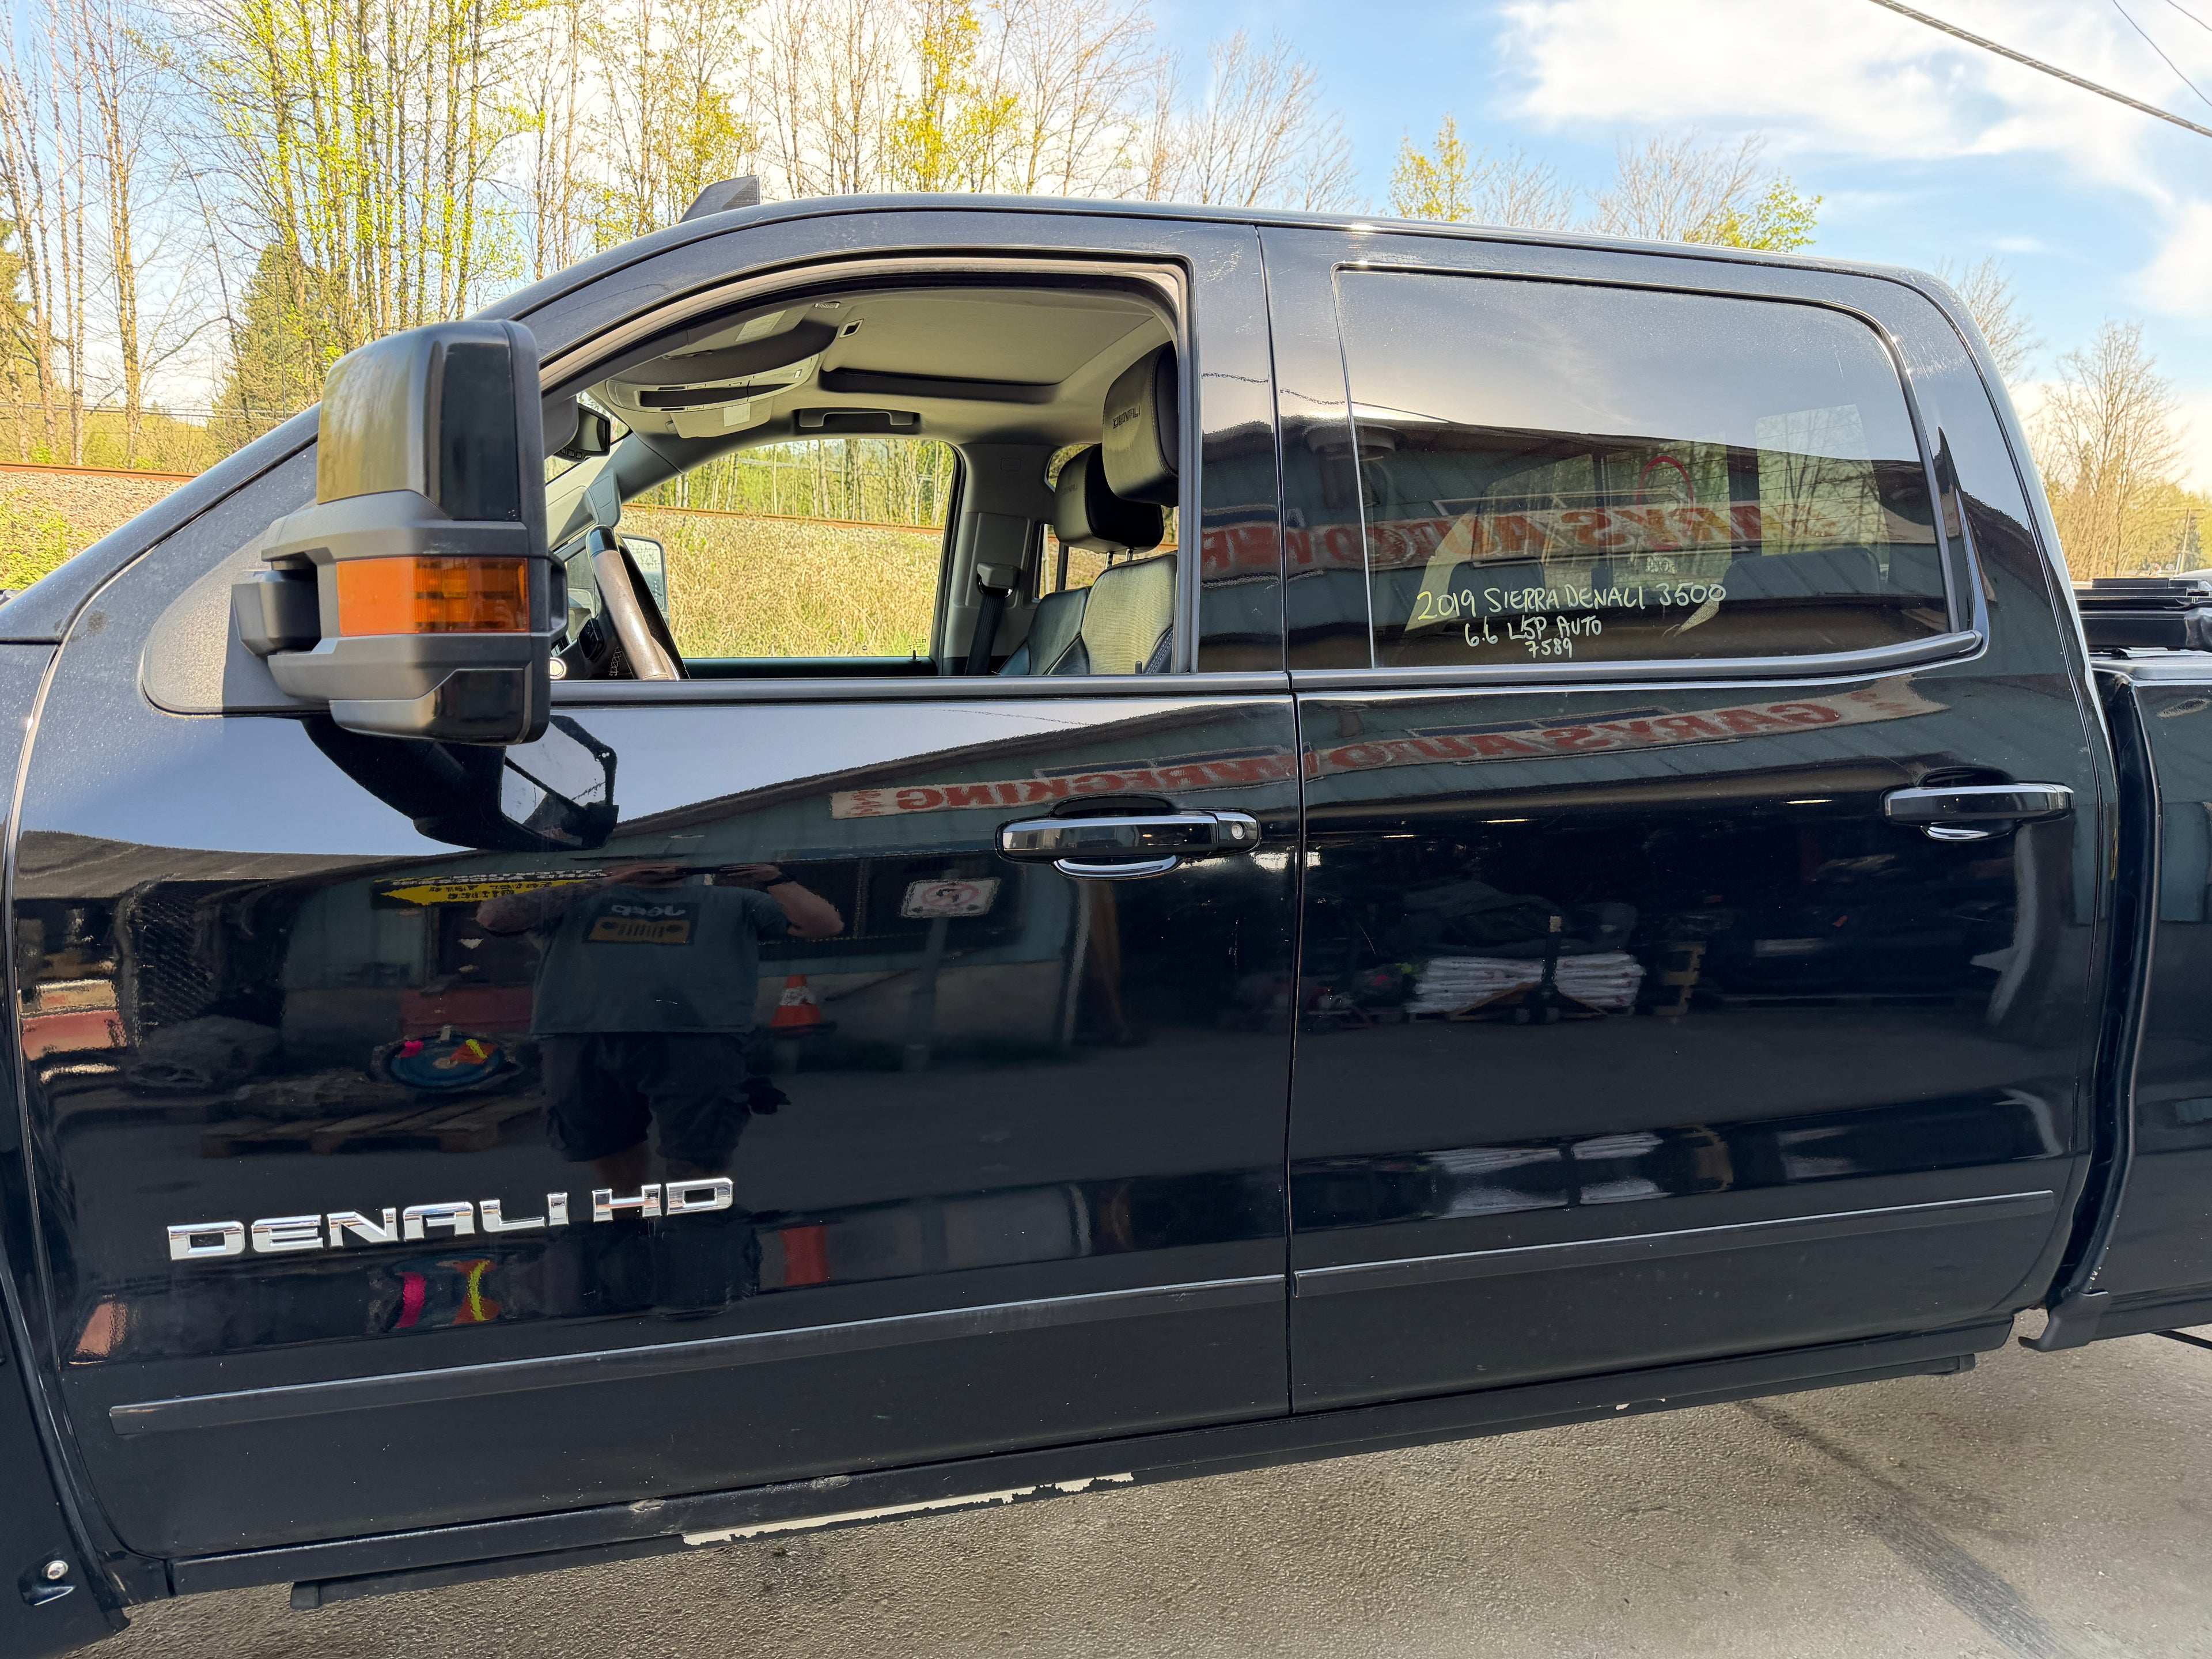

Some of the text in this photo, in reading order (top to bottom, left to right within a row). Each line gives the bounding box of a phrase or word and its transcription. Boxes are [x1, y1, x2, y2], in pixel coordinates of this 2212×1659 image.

[1417, 582, 1727, 620] 2019 SIERRA DENALI 3500
[1464, 615, 1603, 647] 6.6 L5P AUTO
[1527, 637, 1574, 658] 7589
[166, 1177, 734, 1261] DENALI HD
